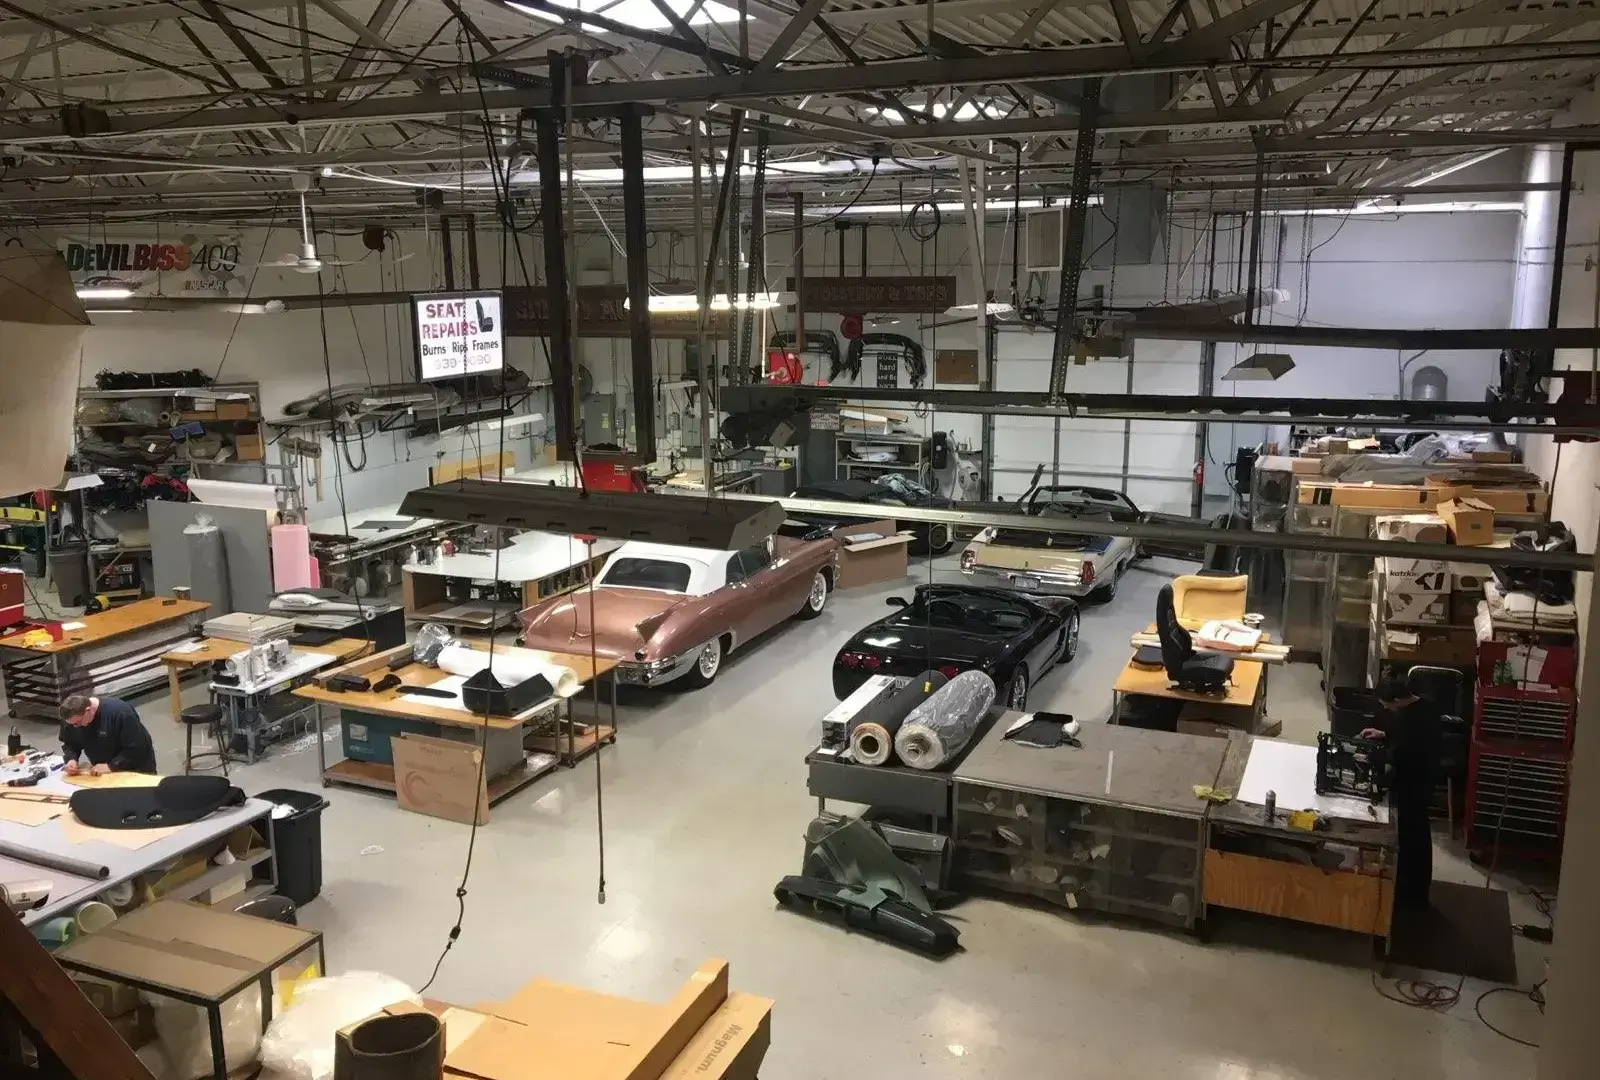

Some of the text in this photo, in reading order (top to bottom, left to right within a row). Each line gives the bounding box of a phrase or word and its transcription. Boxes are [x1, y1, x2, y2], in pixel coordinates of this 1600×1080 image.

[192, 244, 238, 272] 400
[426, 302, 464, 318] SEAT
[422, 321, 478, 340] REPAIRS
[422, 339, 499, 356] Burns Rips Frames
[697, 1022, 745, 1073] Magnum
